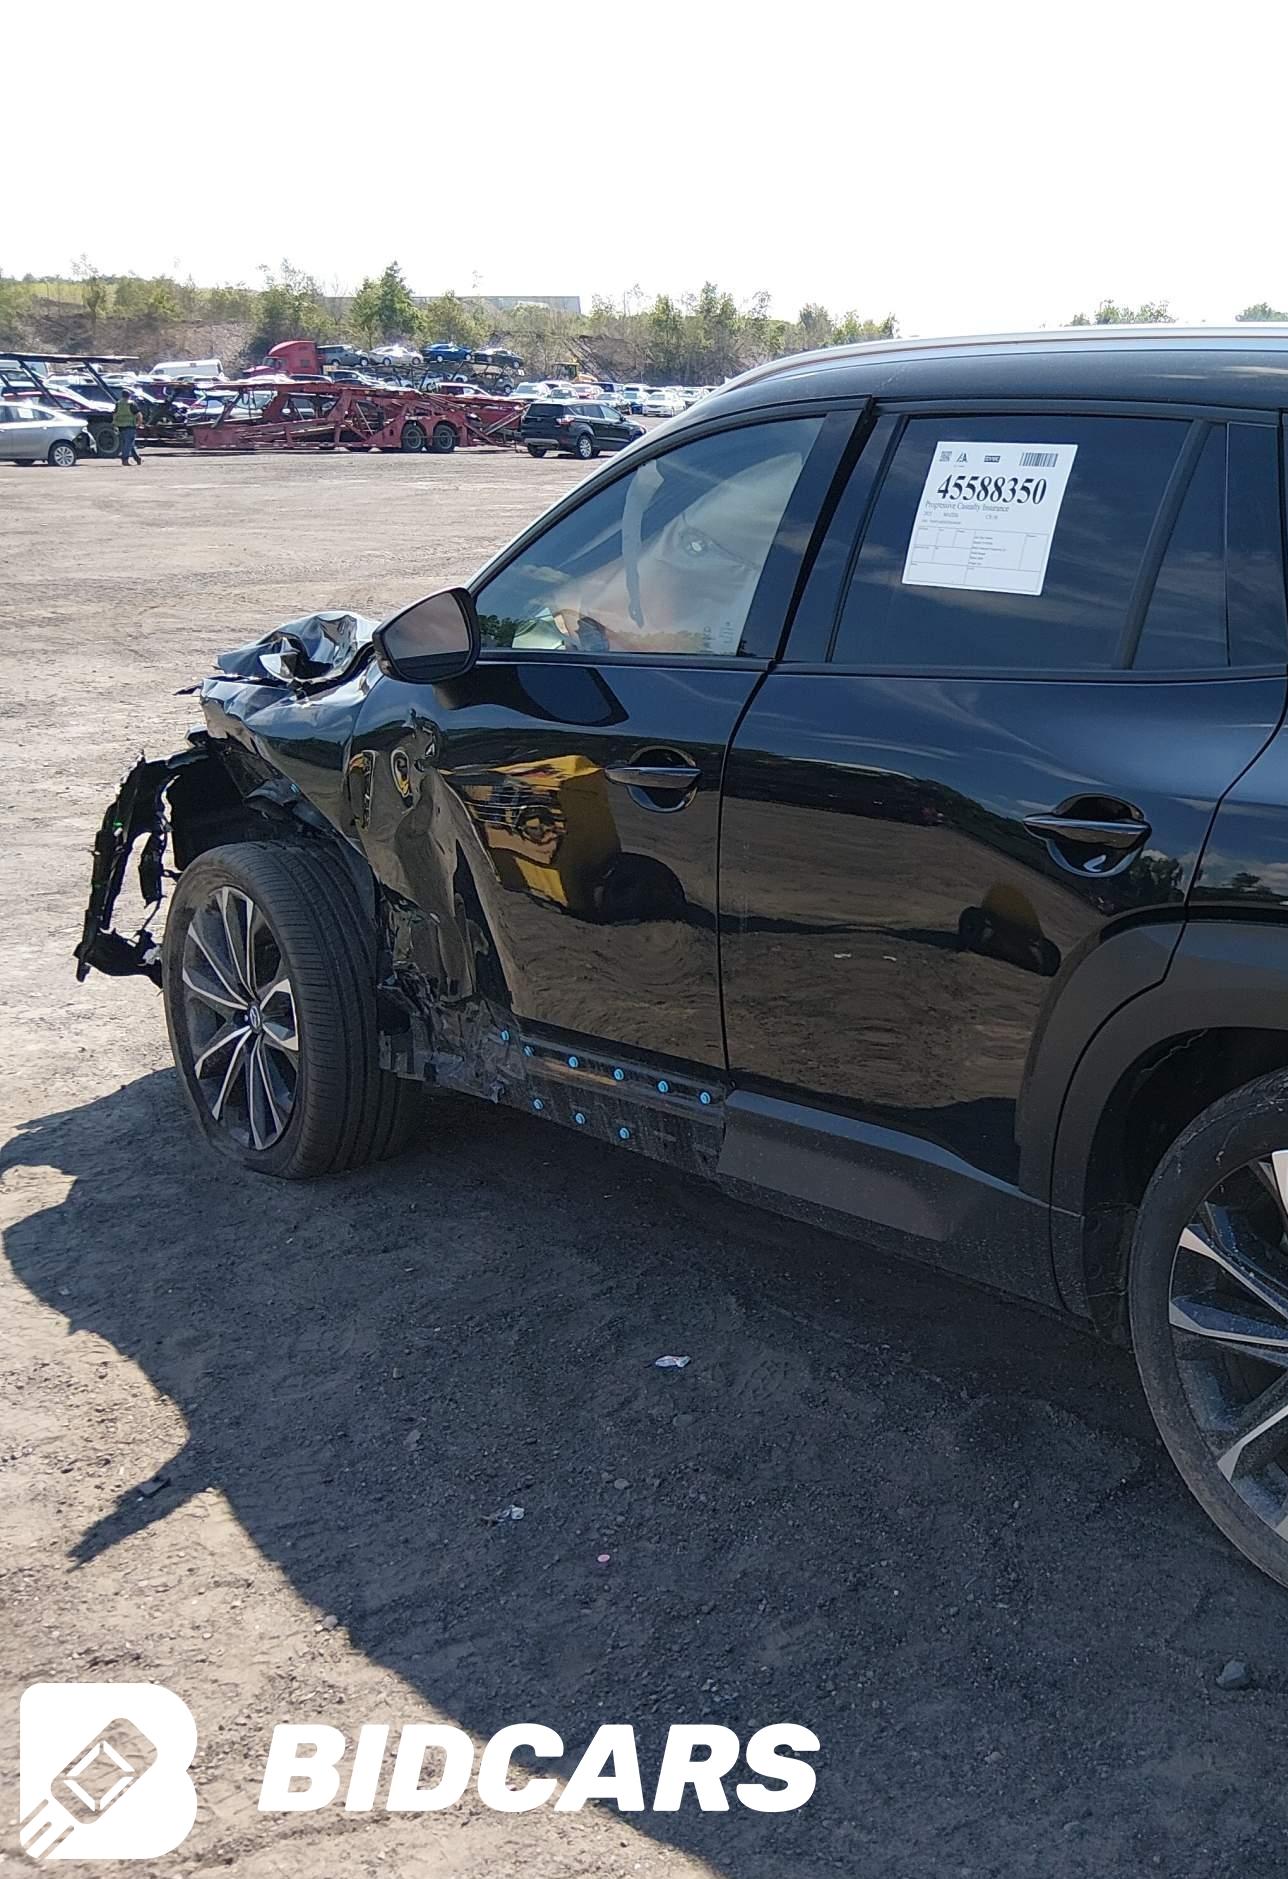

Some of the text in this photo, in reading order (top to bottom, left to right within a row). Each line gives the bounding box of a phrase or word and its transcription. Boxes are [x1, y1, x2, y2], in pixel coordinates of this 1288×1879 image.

[937, 474, 1047, 504] 45588350
[925, 500, 956, 512] Progressive
[982, 503, 1010, 513] Insurance
